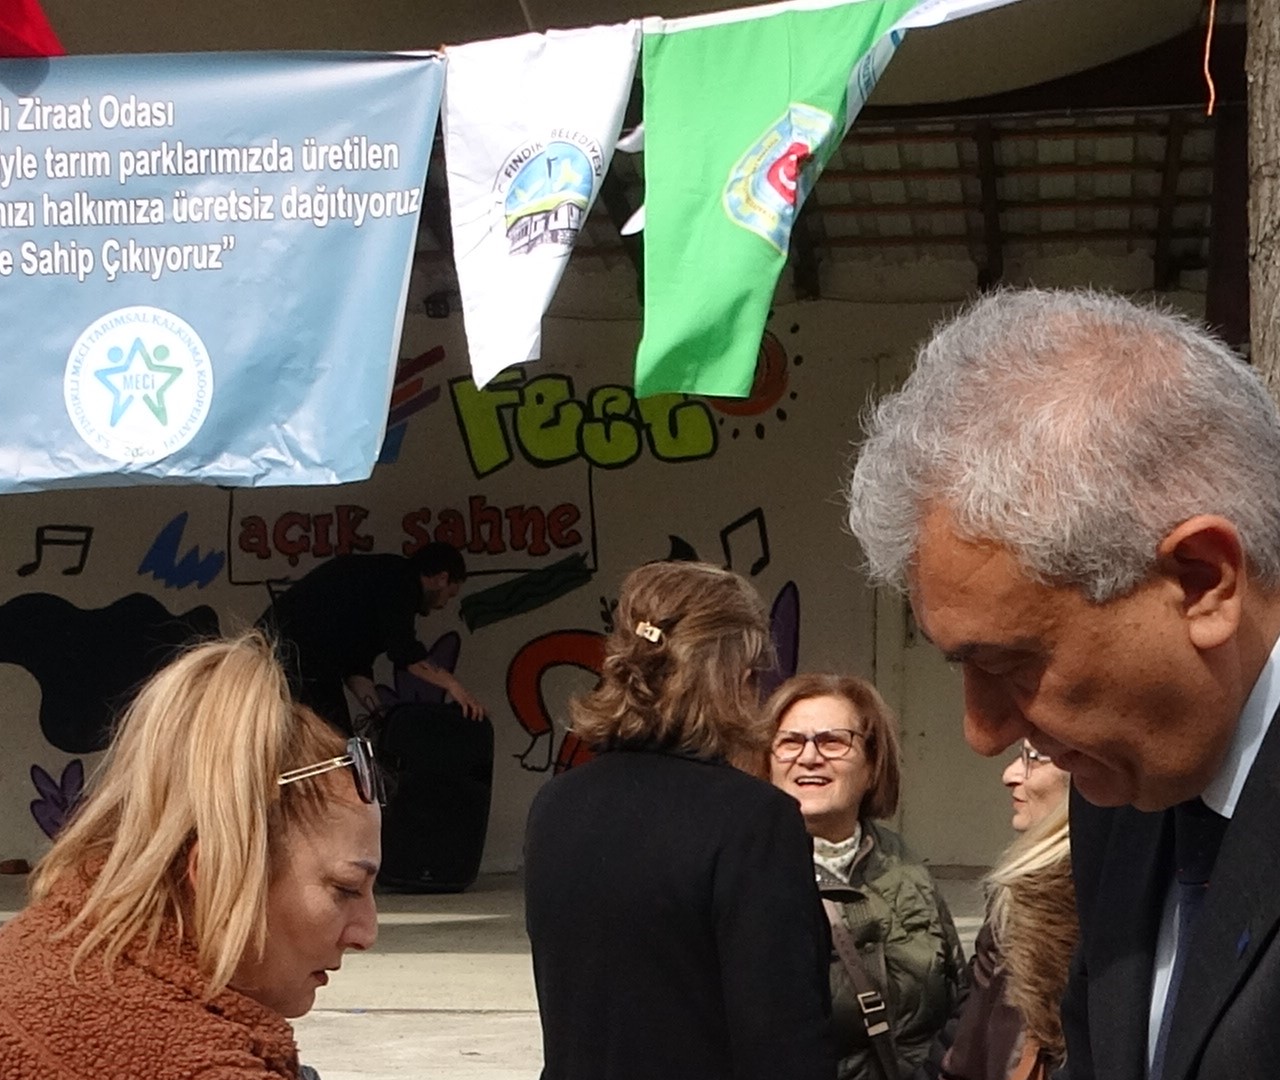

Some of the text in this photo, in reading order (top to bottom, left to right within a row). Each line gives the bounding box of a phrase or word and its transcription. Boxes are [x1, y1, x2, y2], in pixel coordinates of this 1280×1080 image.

[17, 97, 92, 132] Ziraat
[99, 94, 174, 129] Odası
[44, 147, 110, 178] tarım
[119, 139, 293, 183] parklarımızda
[301, 135, 399, 172] üretilen
[503, 141, 544, 179] FINDIK
[42, 191, 164, 228] halkımıza
[172, 186, 274, 223] ücretsiz
[281, 185, 421, 228] dağıtıyoruz
[20, 239, 95, 283] Sahip
[86, 311, 151, 345] TARIMSAL
[151, 313, 204, 368] KALKINMA
[122, 373, 156, 391] MECİ
[400, 494, 585, 558] sahne
